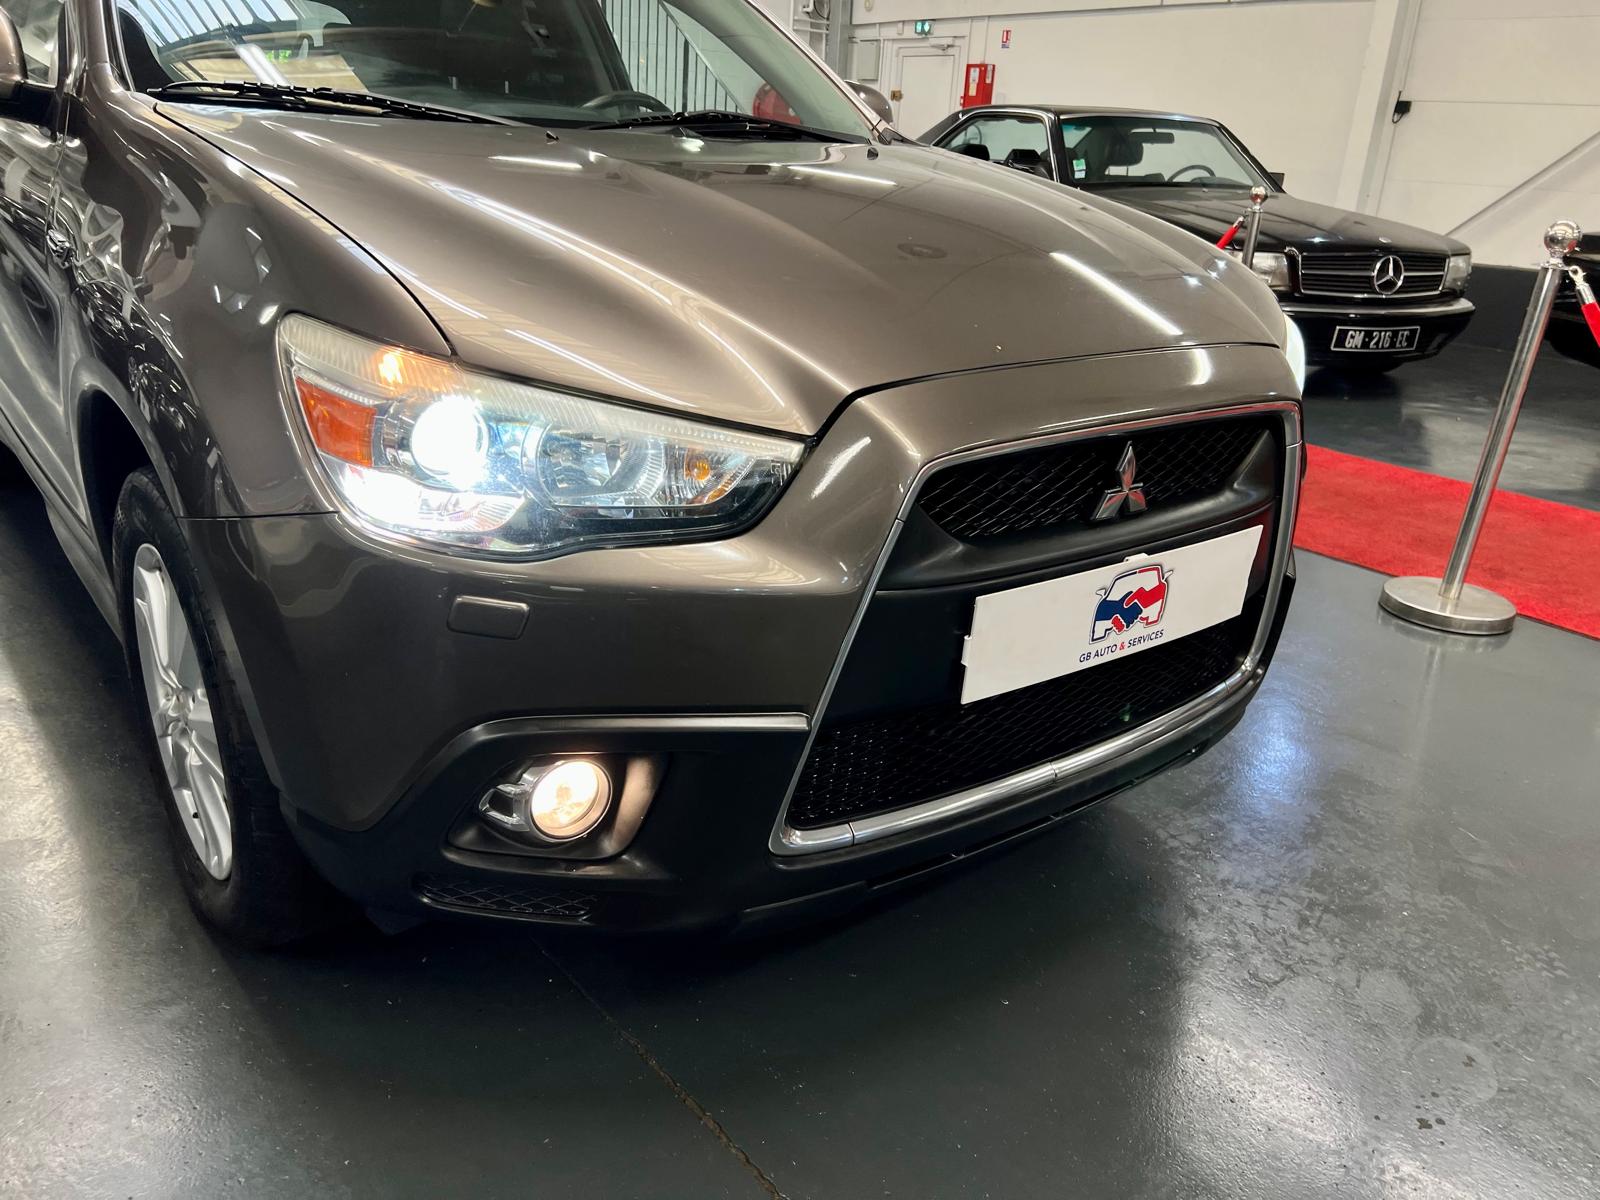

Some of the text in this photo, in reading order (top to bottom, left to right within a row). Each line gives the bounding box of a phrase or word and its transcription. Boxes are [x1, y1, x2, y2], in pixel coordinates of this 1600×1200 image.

[1079, 629, 1164, 663] GB AUTO & SERVICES
